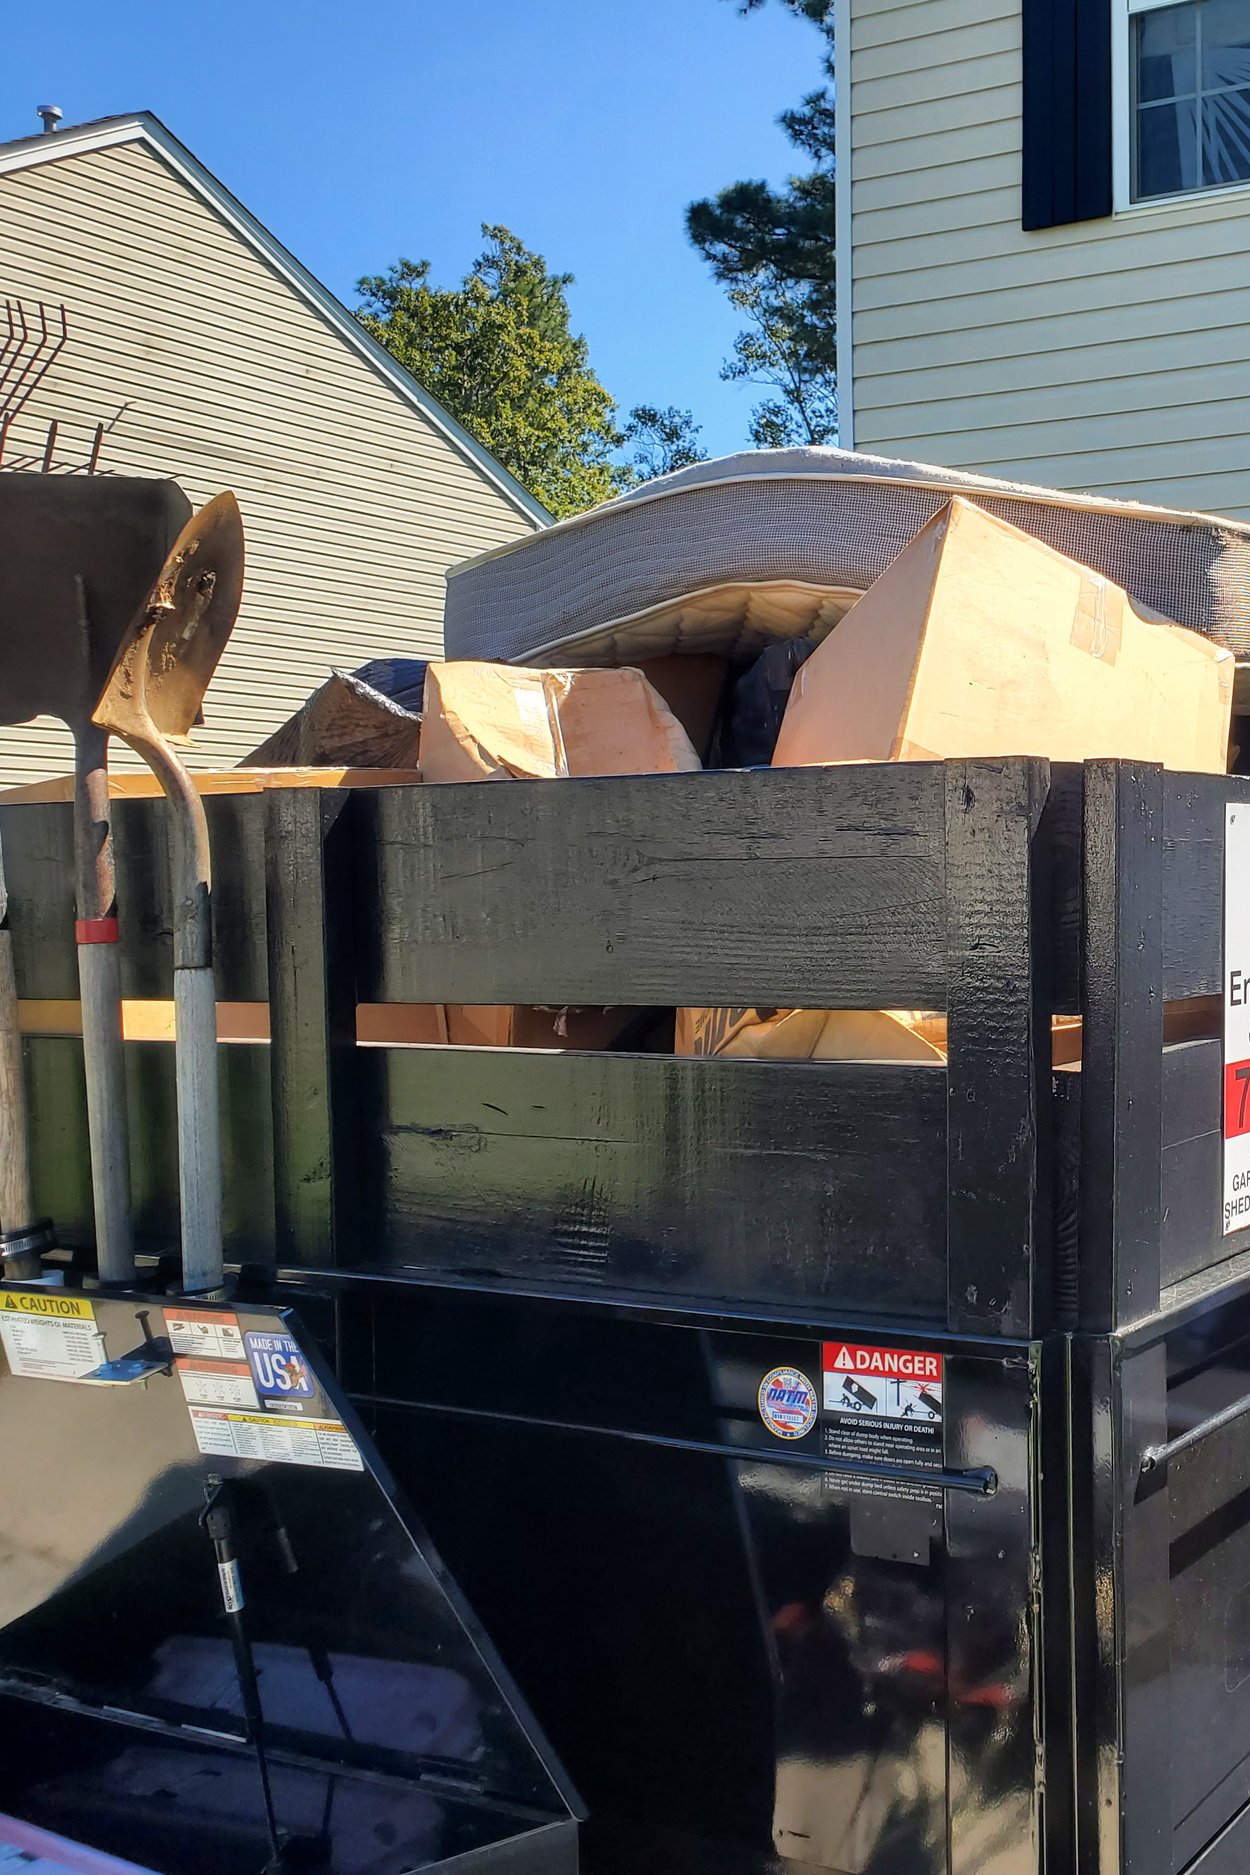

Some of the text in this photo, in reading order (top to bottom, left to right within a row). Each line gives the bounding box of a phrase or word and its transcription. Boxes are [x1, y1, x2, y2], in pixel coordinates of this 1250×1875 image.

[1224, 1198, 1250, 1220] SHED
[20, 1296, 81, 1315] CAUTION
[249, 1337, 274, 1351] MADE
[274, 1339, 283, 1351] IN
[283, 1340, 299, 1353] THE
[253, 1351, 309, 1392] USA
[856, 1350, 938, 1376] DANGER
[840, 1417, 858, 1425] AVOID
[858, 1419, 883, 1429] SERIOUS
[883, 1422, 904, 1431] INJURY
[913, 1425, 935, 1435] DEATH!
